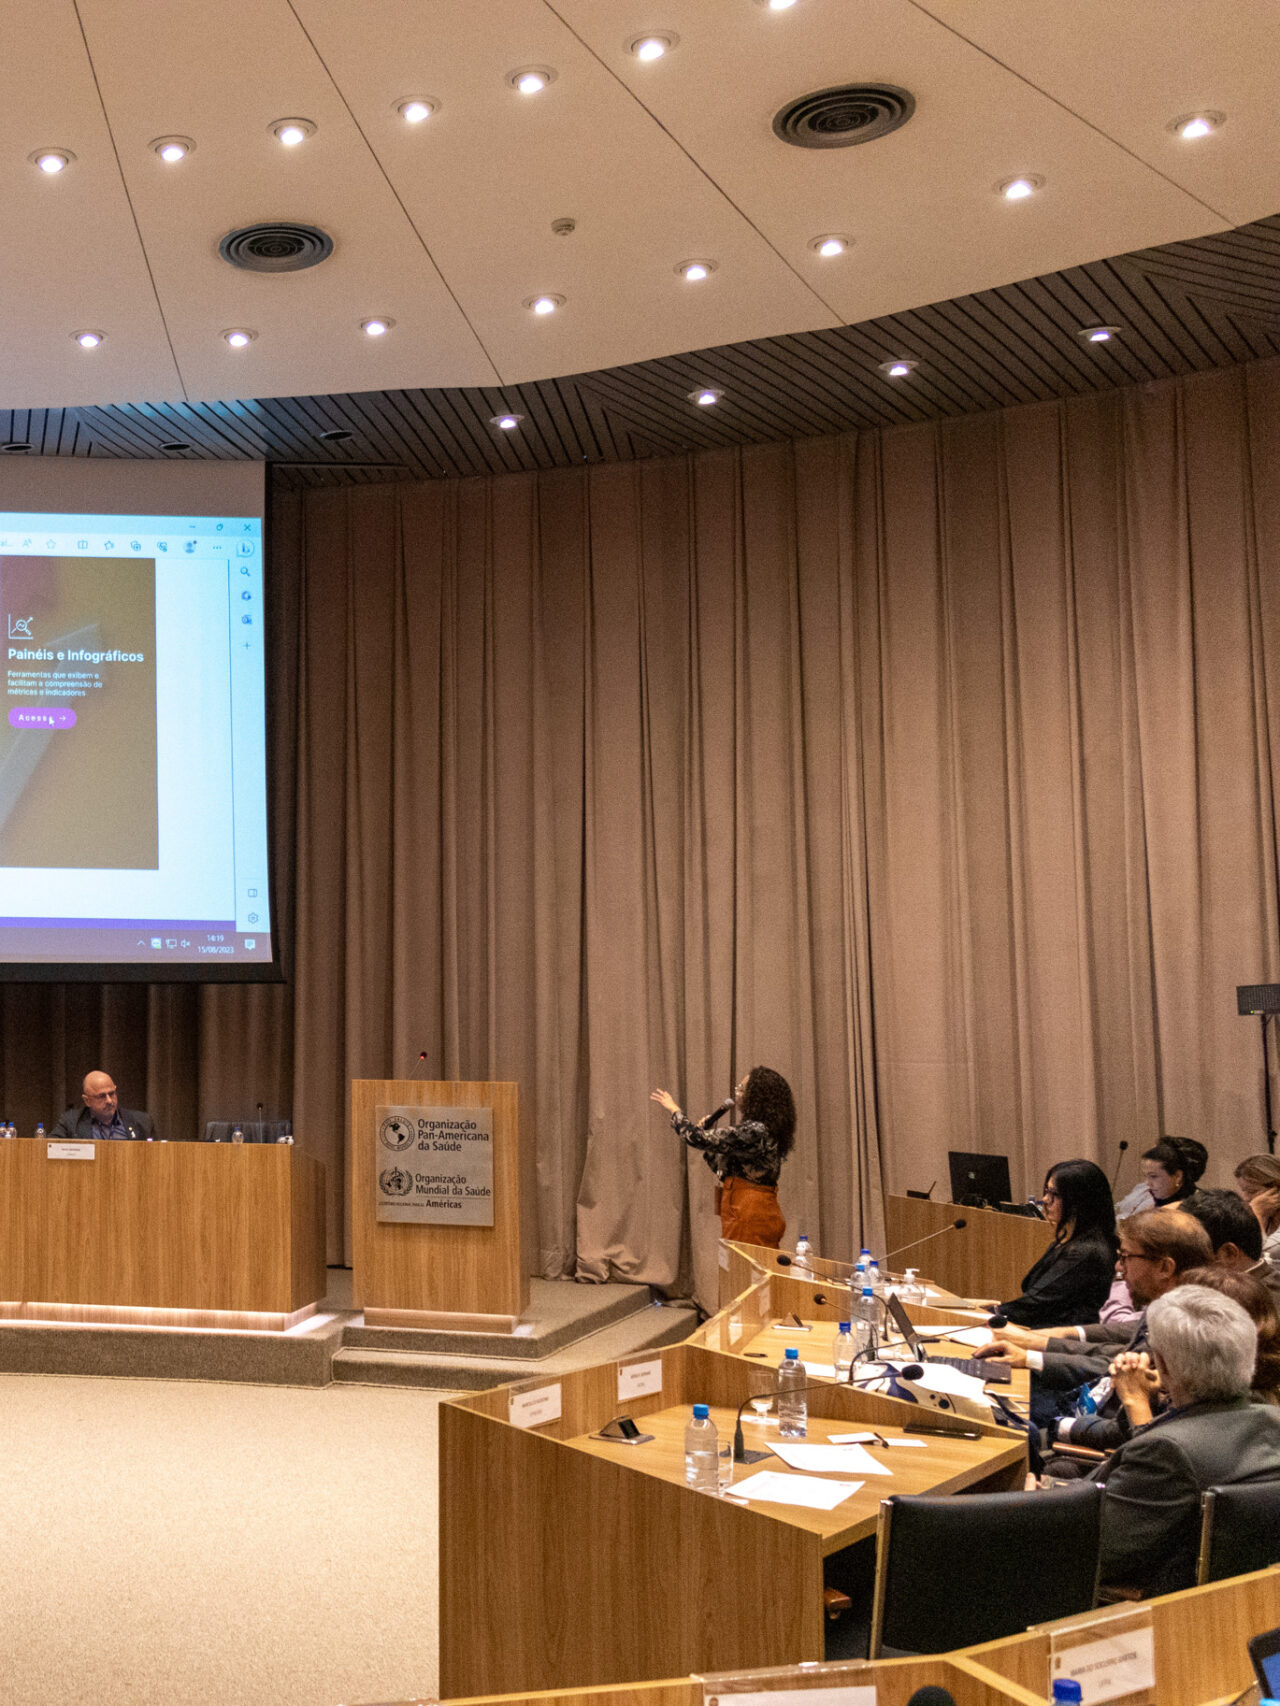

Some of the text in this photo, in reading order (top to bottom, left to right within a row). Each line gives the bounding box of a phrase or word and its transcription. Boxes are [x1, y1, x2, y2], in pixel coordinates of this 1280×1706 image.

[8, 648, 144, 664] Painéis e Infográficos
[8, 670, 51, 679] Ferramentas
[52, 672, 66, 680] que
[68, 671, 93, 680] exibem
[8, 679, 37, 687] facilitam
[45, 680, 92, 688] compreensão
[8, 688, 38, 696] métricas
[46, 688, 86, 697] indicadores
[418, 1119, 476, 1132] Organização
[418, 1130, 489, 1141] Pan-Americana
[418, 1142, 462, 1152] da Saúde
[416, 1174, 466, 1185] Organização
[416, 1185, 491, 1196] Mundial da Saúde
[426, 1200, 462, 1209] Américas
